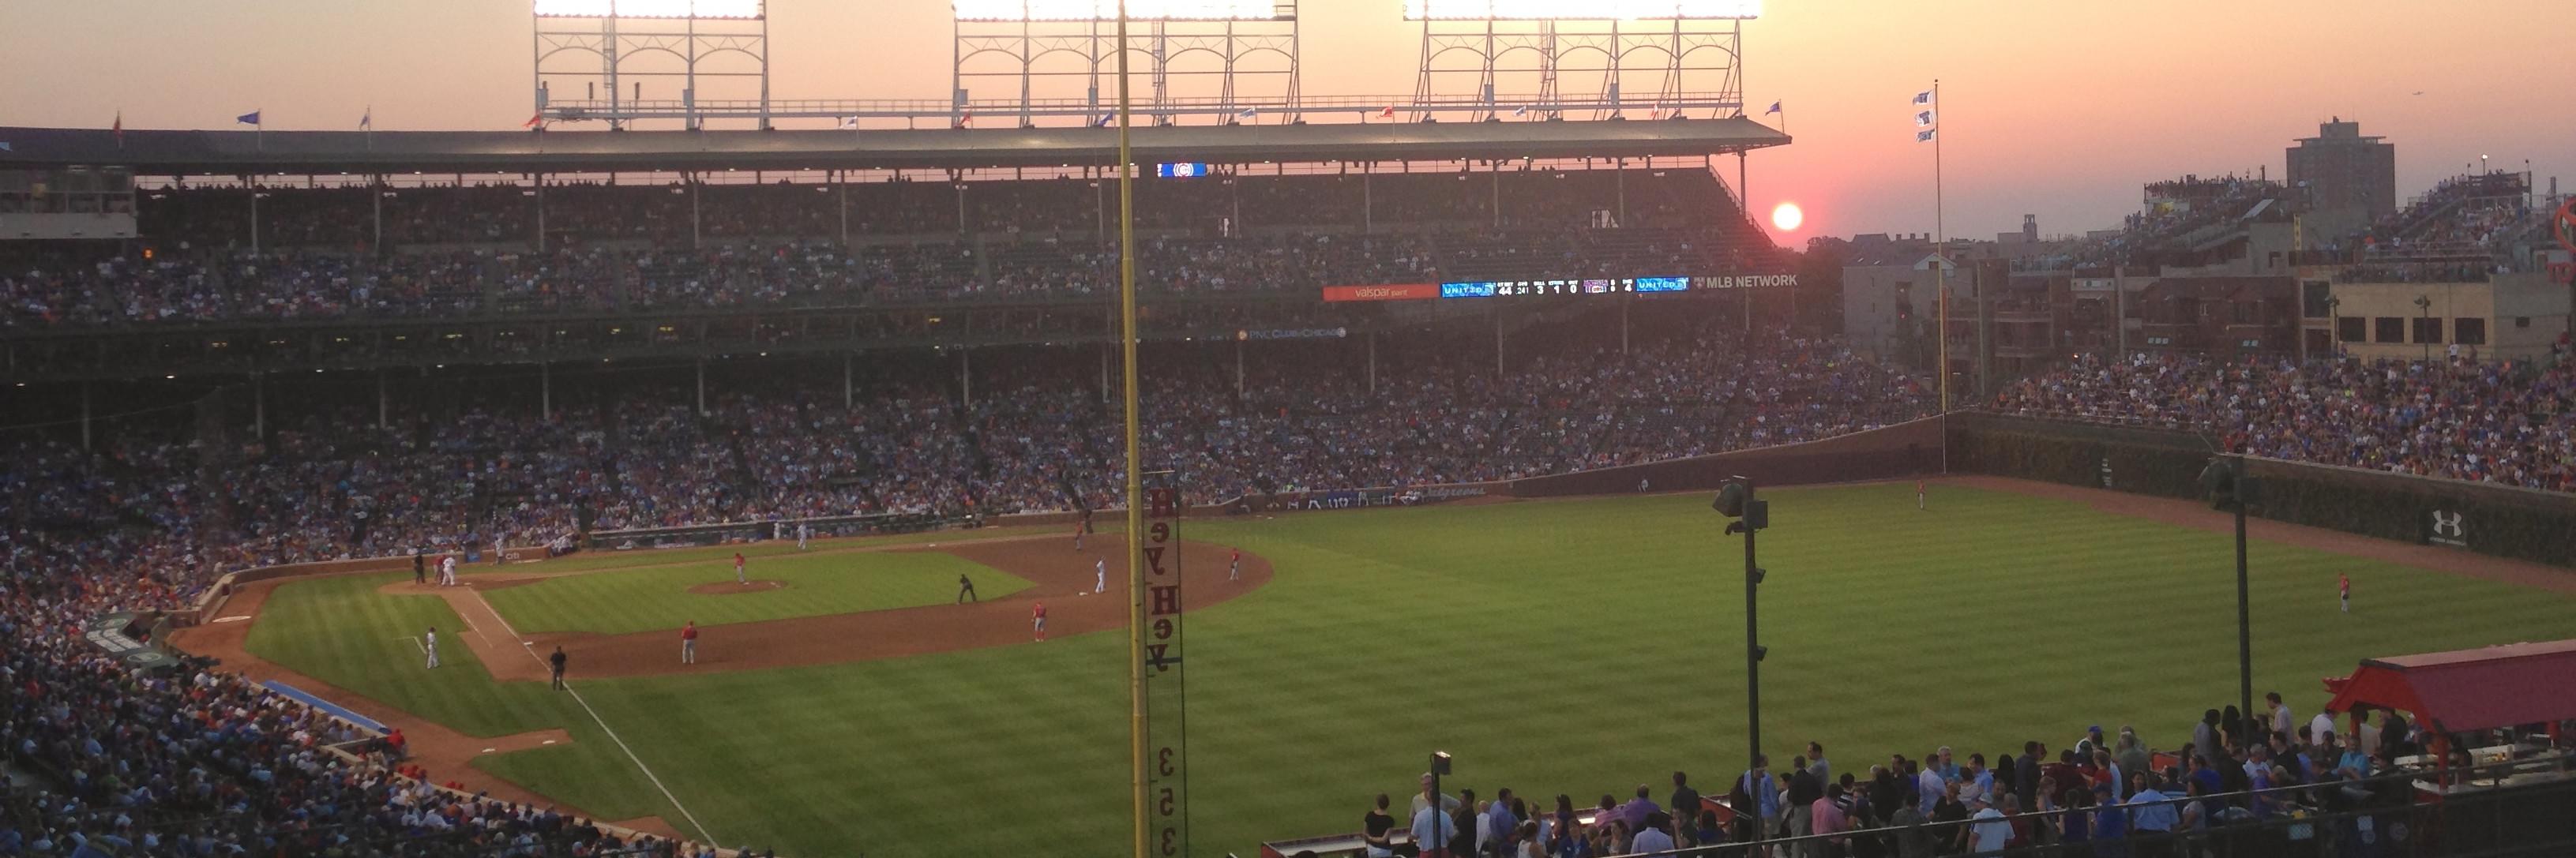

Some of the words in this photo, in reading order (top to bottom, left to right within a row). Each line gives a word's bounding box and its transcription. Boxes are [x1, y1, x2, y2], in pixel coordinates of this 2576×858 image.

[1639, 279, 1675, 289] UNITED
[1707, 276, 1733, 288] MLB
[1736, 275, 1797, 287] NETWORK
[1355, 287, 1391, 299] valspar
[1554, 285, 1560, 294] 1
[1570, 285, 1577, 294] 0
